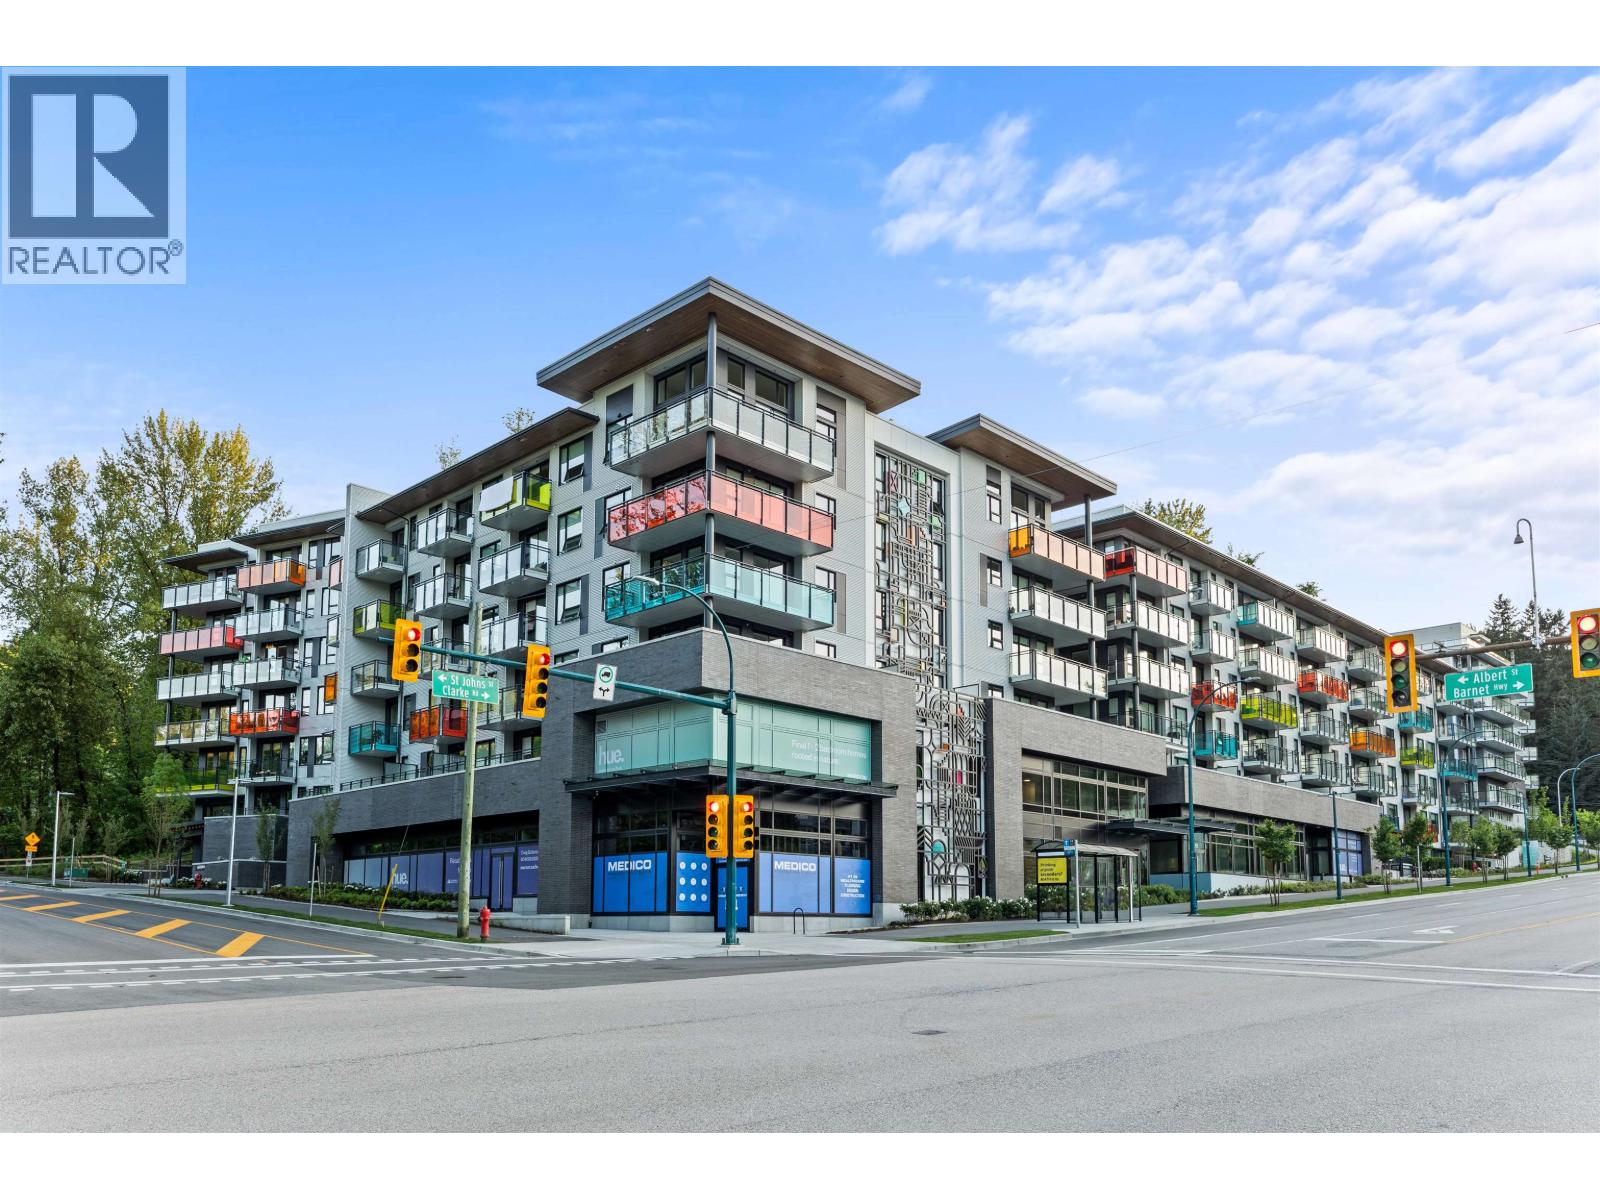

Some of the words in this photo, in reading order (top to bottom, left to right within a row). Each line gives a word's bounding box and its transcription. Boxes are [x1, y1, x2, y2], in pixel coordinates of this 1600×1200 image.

[451, 674, 459, 686] St
[462, 677, 486, 689] Johns
[1473, 670, 1508, 684] Albert
[1511, 668, 1518, 676] St
[442, 685, 469, 698] Clarke
[1453, 685, 1489, 698] Barnet
[1493, 683, 1508, 691] Hwy
[599, 745, 624, 765] hue.
[608, 860, 652, 871] MEDICO
[774, 860, 817, 872] MEDICO
